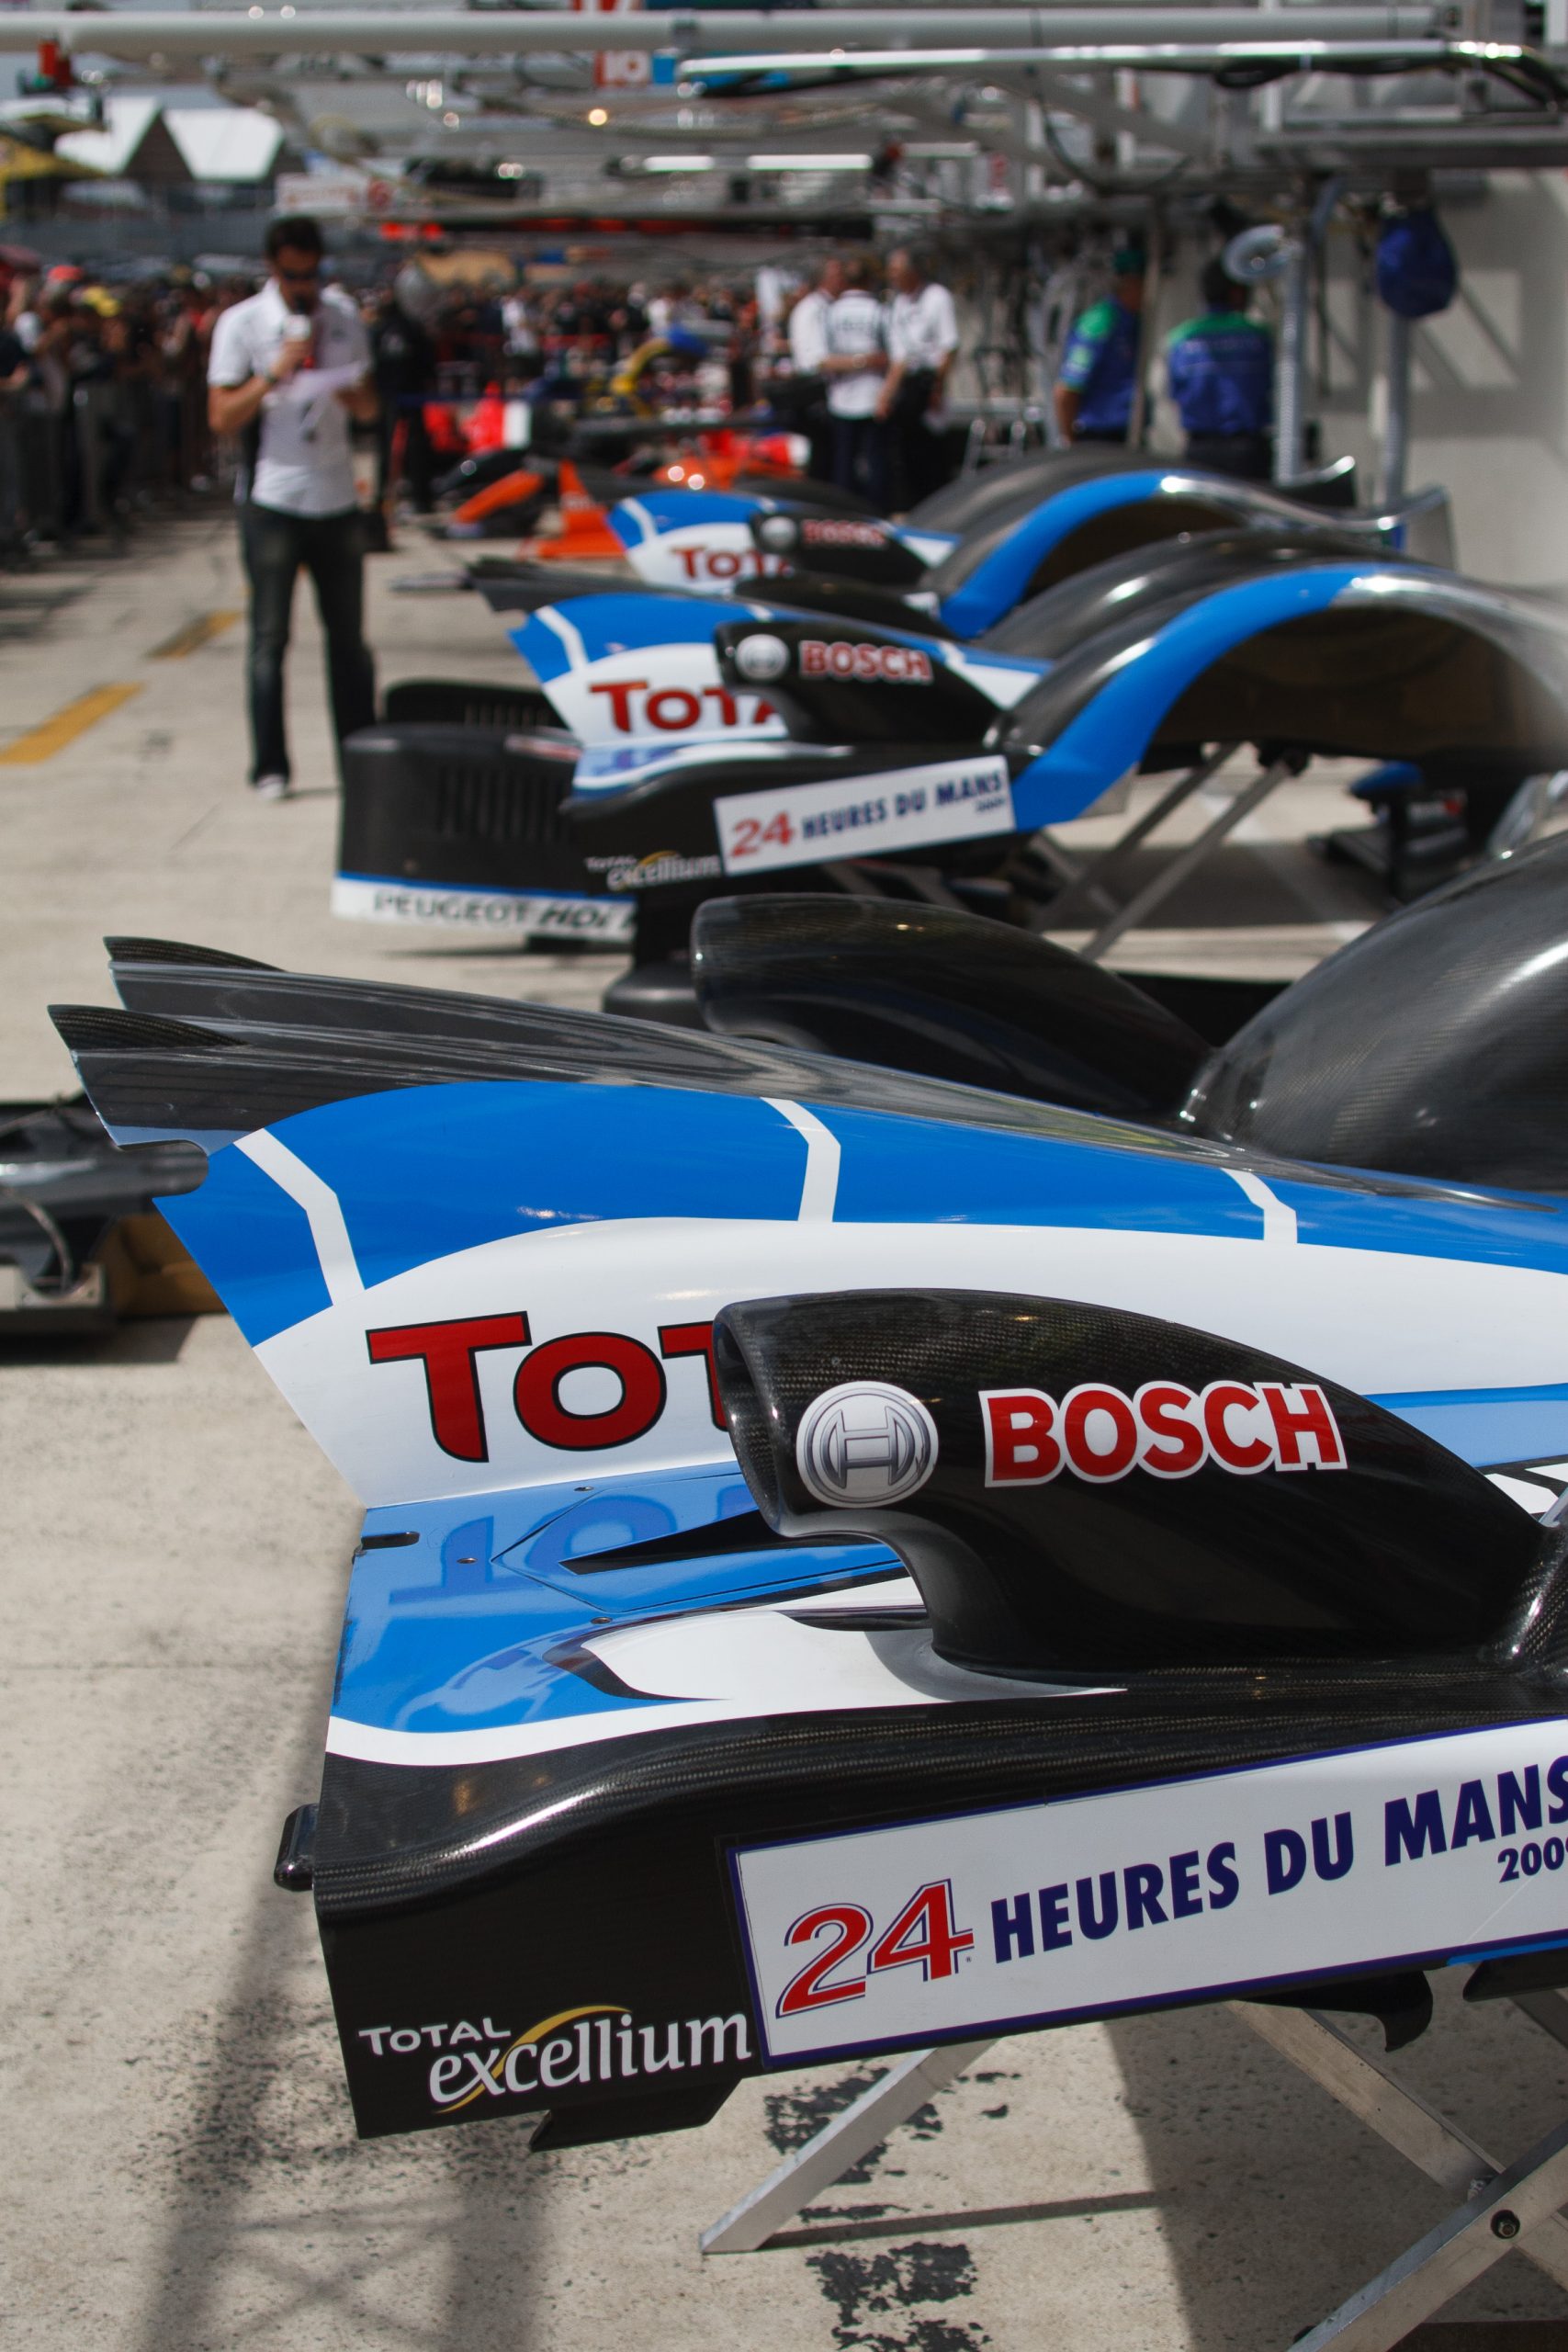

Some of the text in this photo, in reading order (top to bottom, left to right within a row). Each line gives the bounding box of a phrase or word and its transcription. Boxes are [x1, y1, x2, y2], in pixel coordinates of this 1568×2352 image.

[798, 639, 935, 685] BOSCH
[730, 808, 796, 858] 24
[801, 797, 887, 840] HEURES
[894, 787, 927, 818] DU
[935, 768, 1003, 807] MANS
[374, 891, 527, 928] PEUGEOT
[978, 1380, 1348, 1487] BOSCH
[775, 1755, 1568, 2019] 24 HEURES DU MANS
[1497, 1836, 1568, 1883] 200
[357, 2016, 512, 2057] TOTAL
[429, 2012, 753, 2106] excellium
